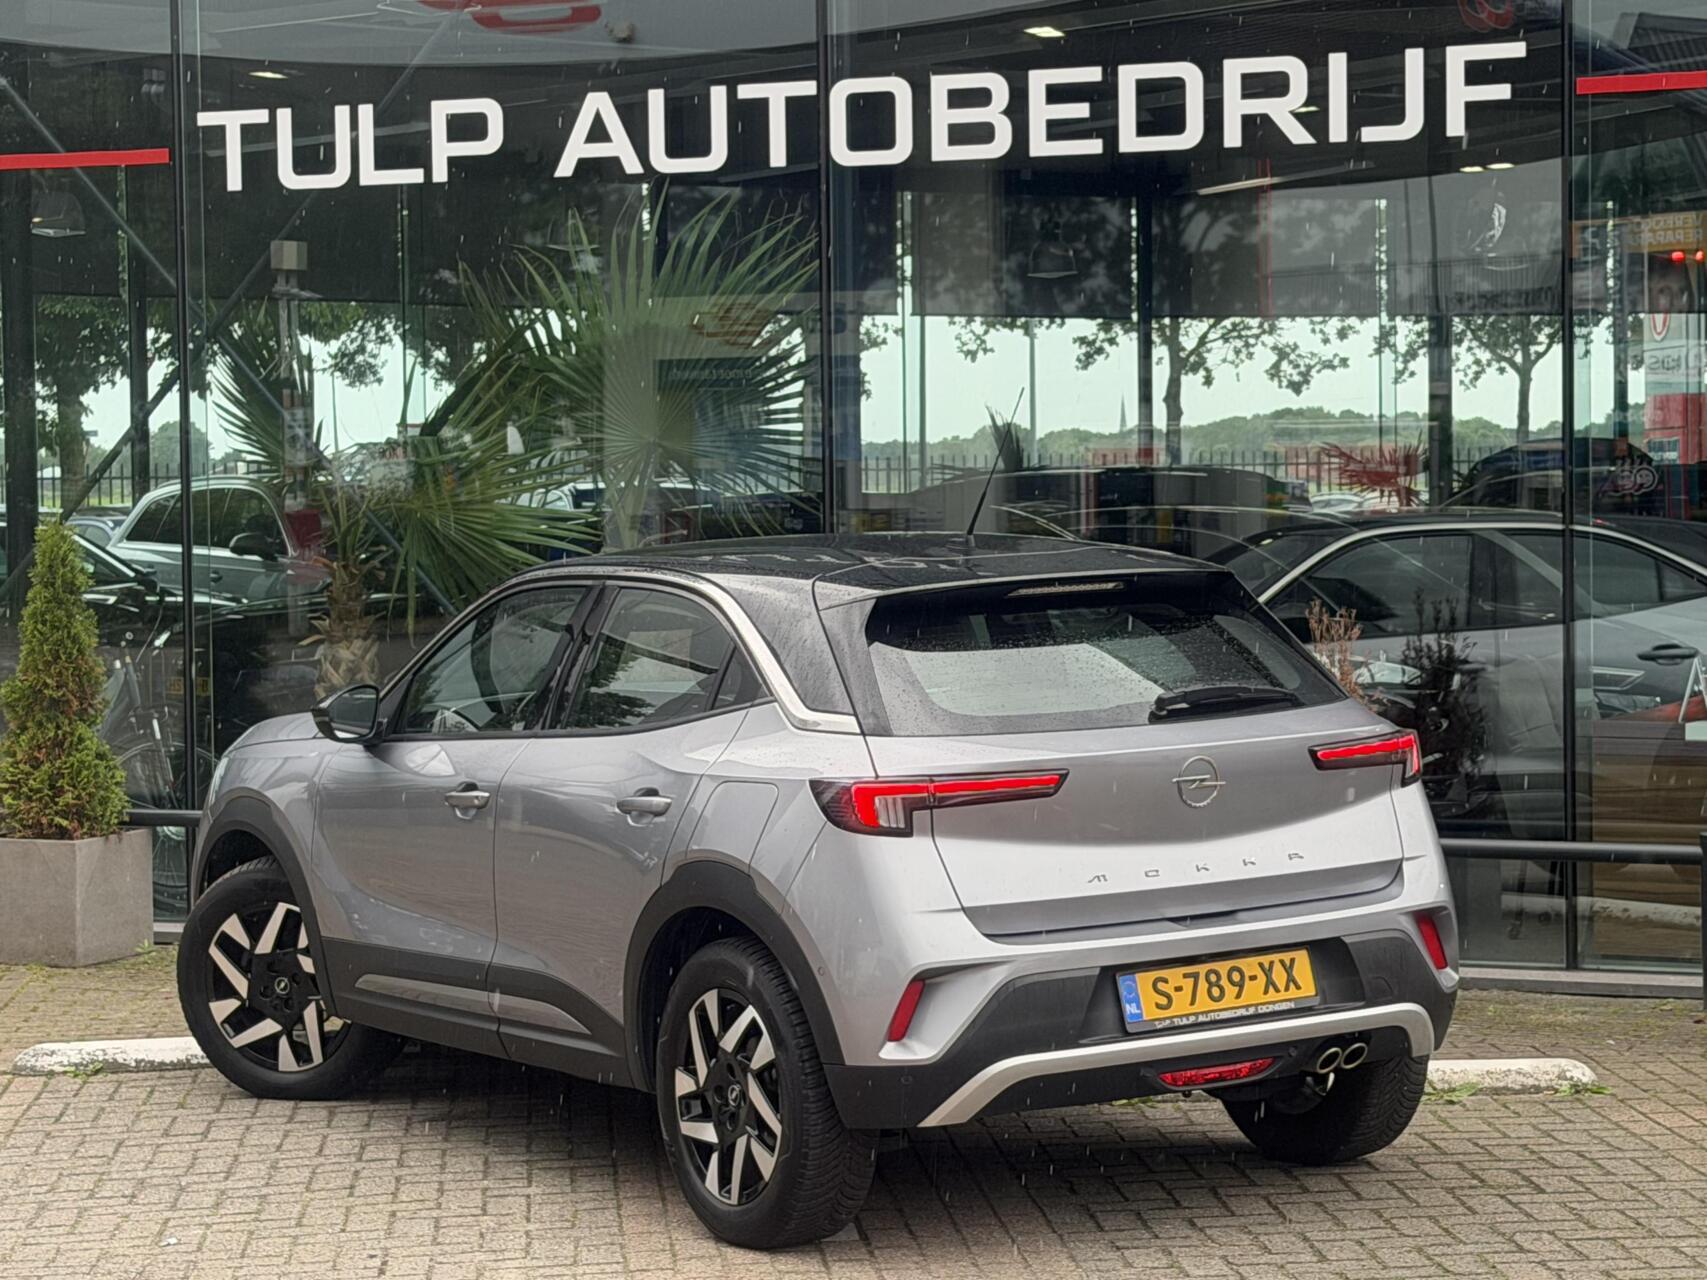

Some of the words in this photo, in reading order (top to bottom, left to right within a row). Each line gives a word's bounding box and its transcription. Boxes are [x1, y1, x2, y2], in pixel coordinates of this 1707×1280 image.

[196, 97, 504, 192] TULP
[554, 41, 1528, 178] AUTOBEDRIJF
[1087, 852, 1305, 884] MOKKA
[1151, 957, 1303, 1011] S-789-XX
[1125, 1002, 1141, 1015] NL
